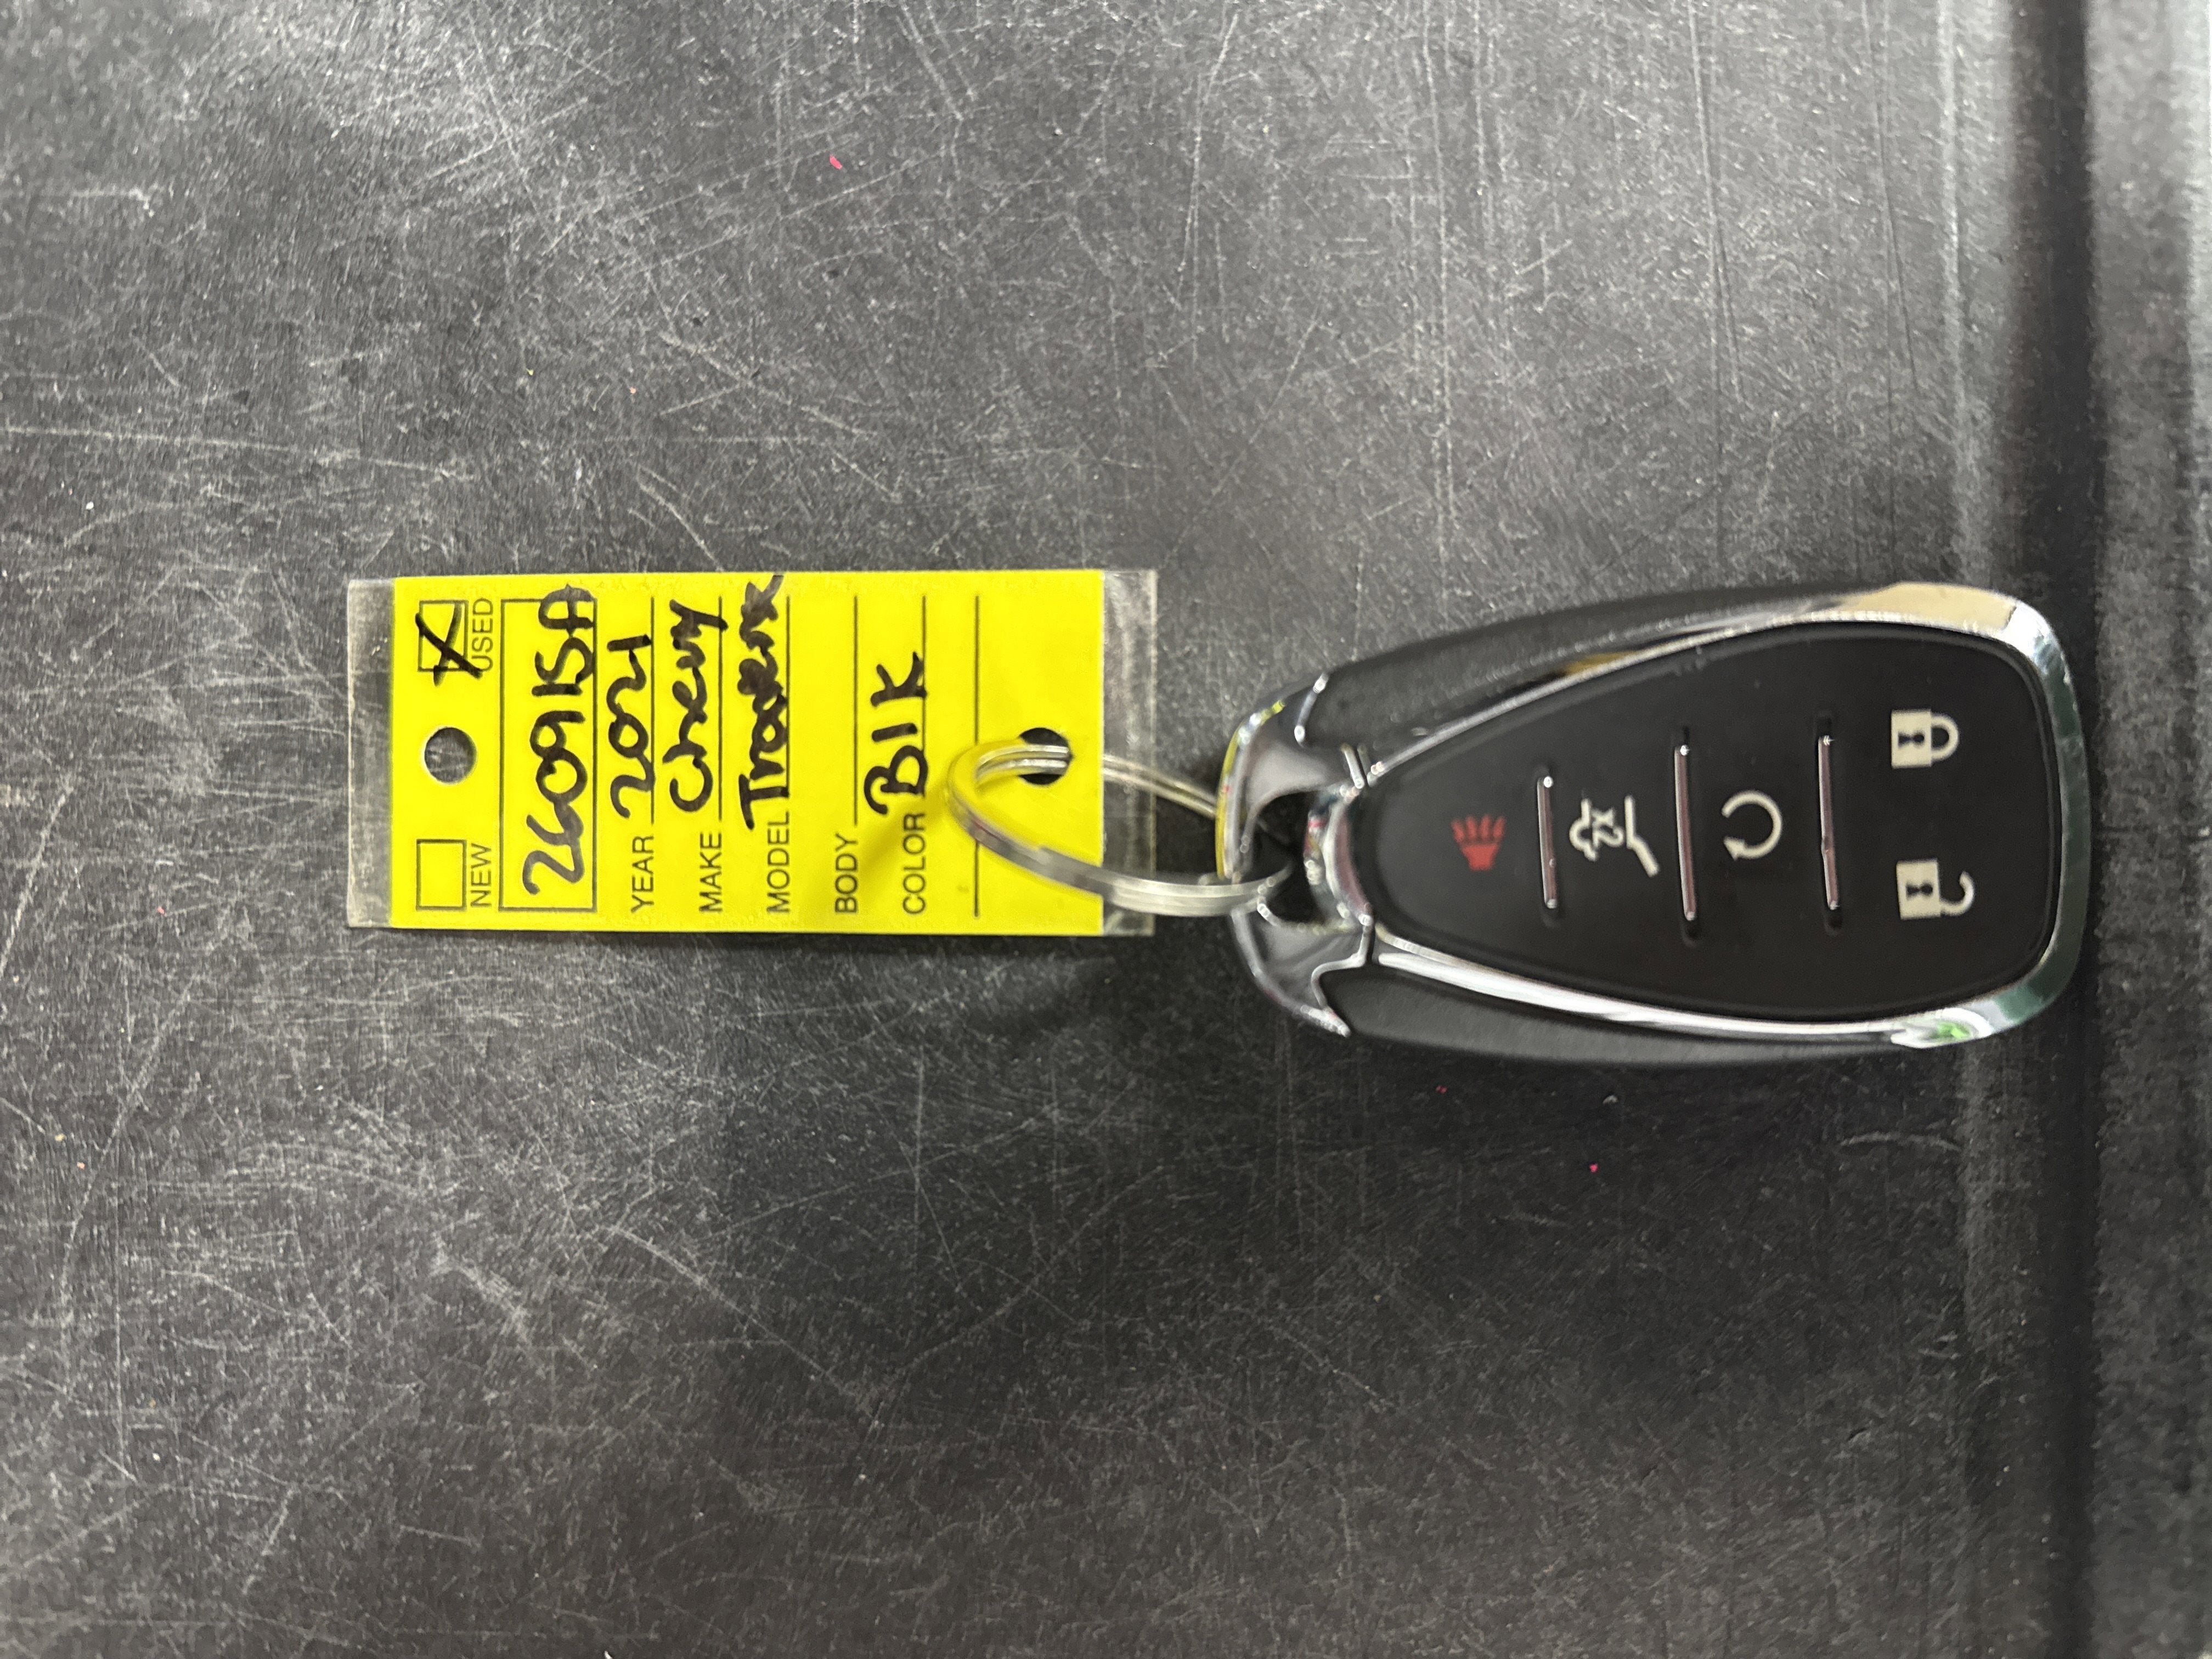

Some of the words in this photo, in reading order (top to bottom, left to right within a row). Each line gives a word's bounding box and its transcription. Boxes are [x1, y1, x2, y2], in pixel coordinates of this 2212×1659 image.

[471, 598, 494, 671] USED
[606, 635, 654, 819] 2021
[663, 600, 727, 812] Chevy
[471, 843, 493, 907] NEW
[631, 836, 653, 912] YEAR
[699, 832, 722, 913] MAKE
[768, 812, 789, 913] MODEL
[835, 834, 857, 913] BODY
[903, 812, 926, 915] COLOR
